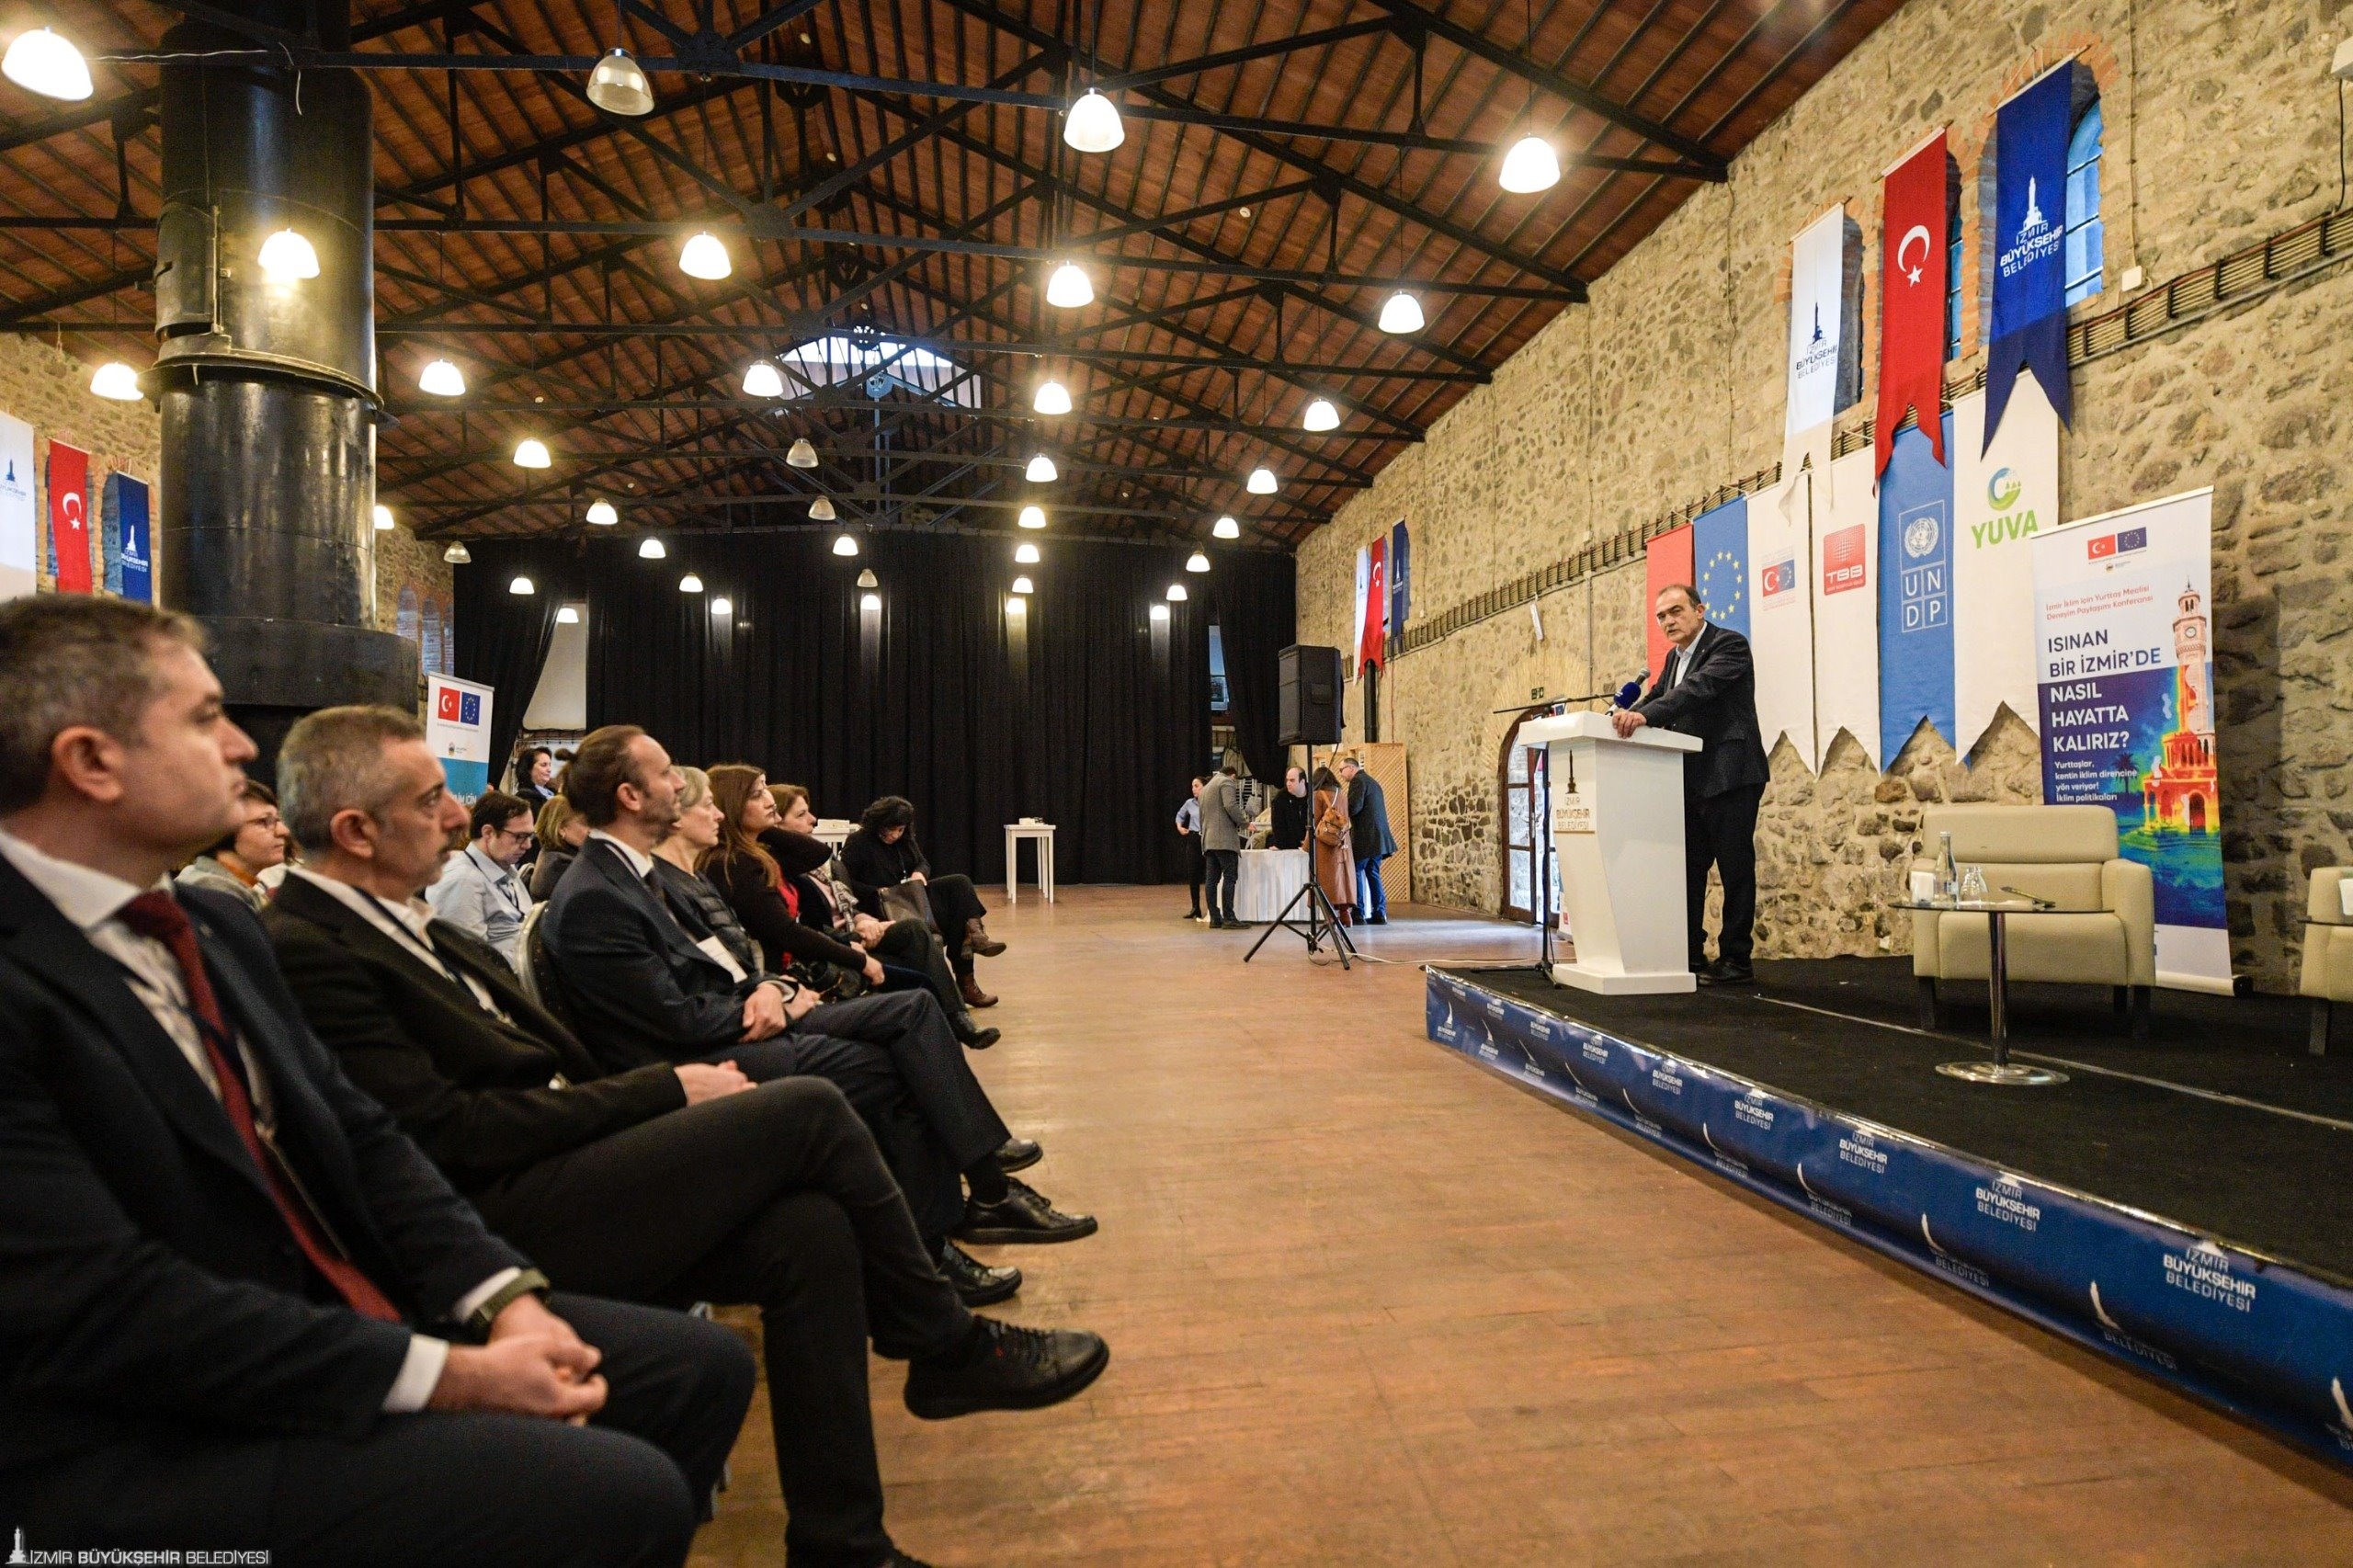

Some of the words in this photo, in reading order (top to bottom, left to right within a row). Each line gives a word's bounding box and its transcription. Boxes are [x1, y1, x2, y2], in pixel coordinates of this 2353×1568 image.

[2003, 240, 2061, 278] BELEDİYES
[1972, 509, 2039, 549] YUVA
[1825, 564, 1863, 584] TBB
[2122, 585, 2150, 596] Meclisi
[2048, 629, 2109, 653] ISINAN
[2050, 657, 2075, 677] BİR
[2050, 682, 2103, 703] NASIL
[2052, 704, 2130, 728] HAYATTA
[2052, 731, 2130, 753] KALIRIZ?
[2055, 772, 2078, 780] kentin
[2079, 770, 2097, 778] iklim
[2099, 769, 2138, 778] direncine
[2071, 781, 2099, 791] veriyor!
[1977, 1200, 2037, 1232] BELEDİYESİ
[2163, 1254, 2256, 1300] BÜYÜKŞEHİR
[2165, 1270, 2251, 1312] BELEDİYESİ
